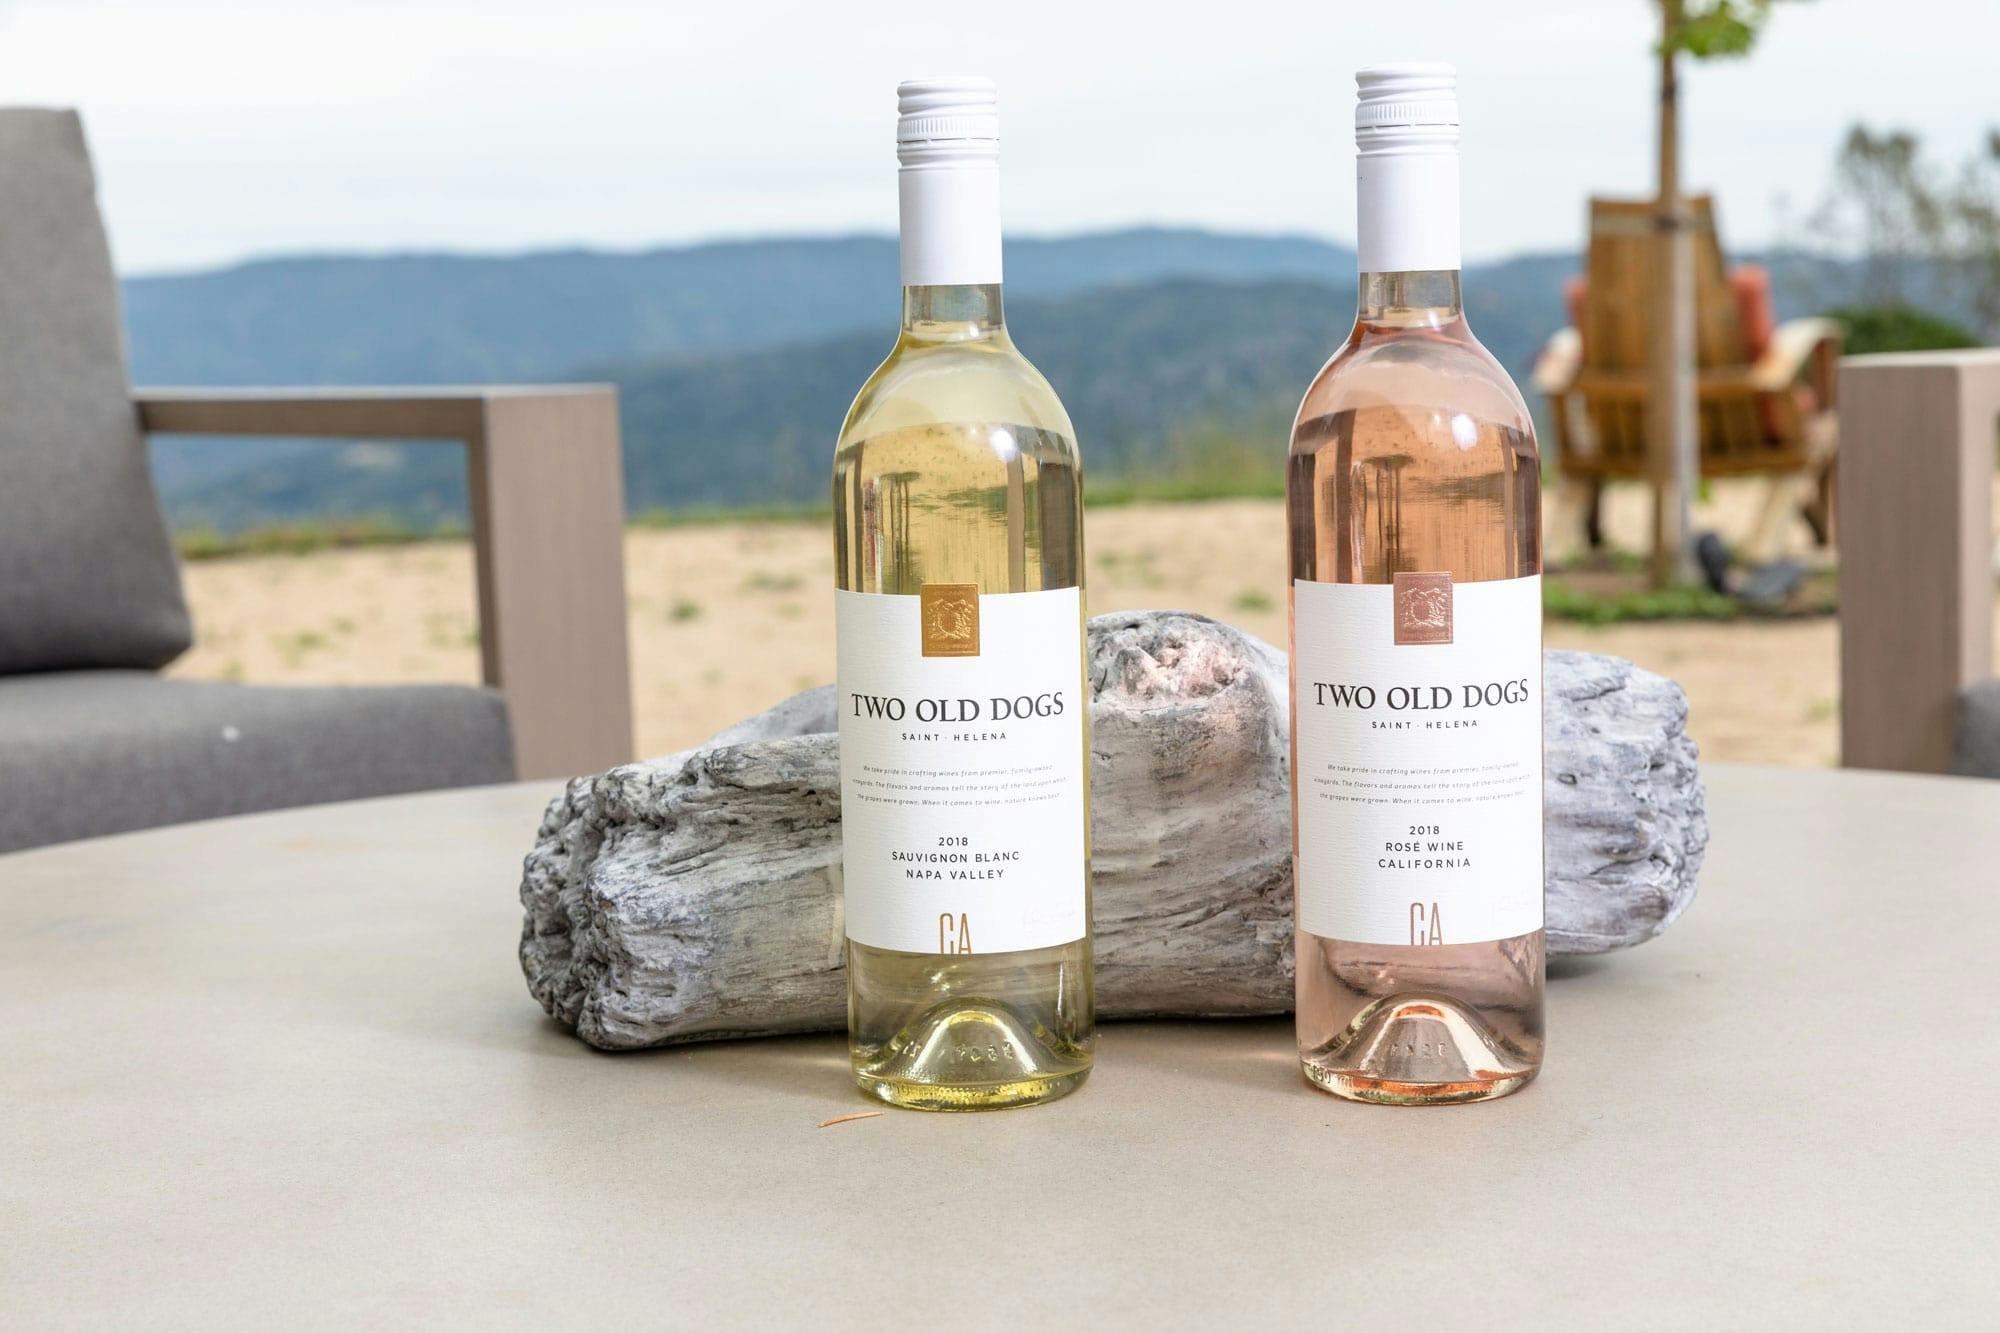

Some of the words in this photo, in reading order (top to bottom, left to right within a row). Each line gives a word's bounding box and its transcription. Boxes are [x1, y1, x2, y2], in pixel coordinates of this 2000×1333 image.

[1313, 682, 1376, 710] TWO
[1386, 686, 1452, 710] OLD
[1462, 678, 1529, 708] DOGS
[851, 693, 906, 721] TWO
[915, 698, 980, 722] OLD
[990, 691, 1064, 721] DOGS
[1371, 721, 1412, 729] SAINT
[1426, 719, 1478, 729] HELENA
[901, 732, 940, 742] SAINT
[953, 732, 1007, 742] HELENA
[908, 769, 937, 778] crafting
[960, 770, 979, 778] from
[1378, 768, 1408, 776] crafting
[886, 782, 908, 790] flavors
[951, 784, 965, 792] tell
[980, 784, 999, 792] story
[1001, 782, 1008, 791] of
[1342, 779, 1353, 787] The
[1353, 781, 1379, 789] flavors
[1452, 782, 1471, 790] story
[1329, 794, 1349, 802] grapes
[1409, 825, 1441, 836] 2018
[938, 836, 969, 847] 2018
[1385, 840, 1421, 852] ROSÉ
[1427, 841, 1464, 852] WINE
[891, 851, 968, 863] SAUVIGNON
[975, 851, 1020, 863] BLANC
[1378, 858, 1471, 869] CALIFORNIA
[906, 869, 942, 880] NAPA
[949, 869, 1005, 880] VALLEY
[1410, 902, 1443, 946] CA
[939, 912, 974, 954] CA
